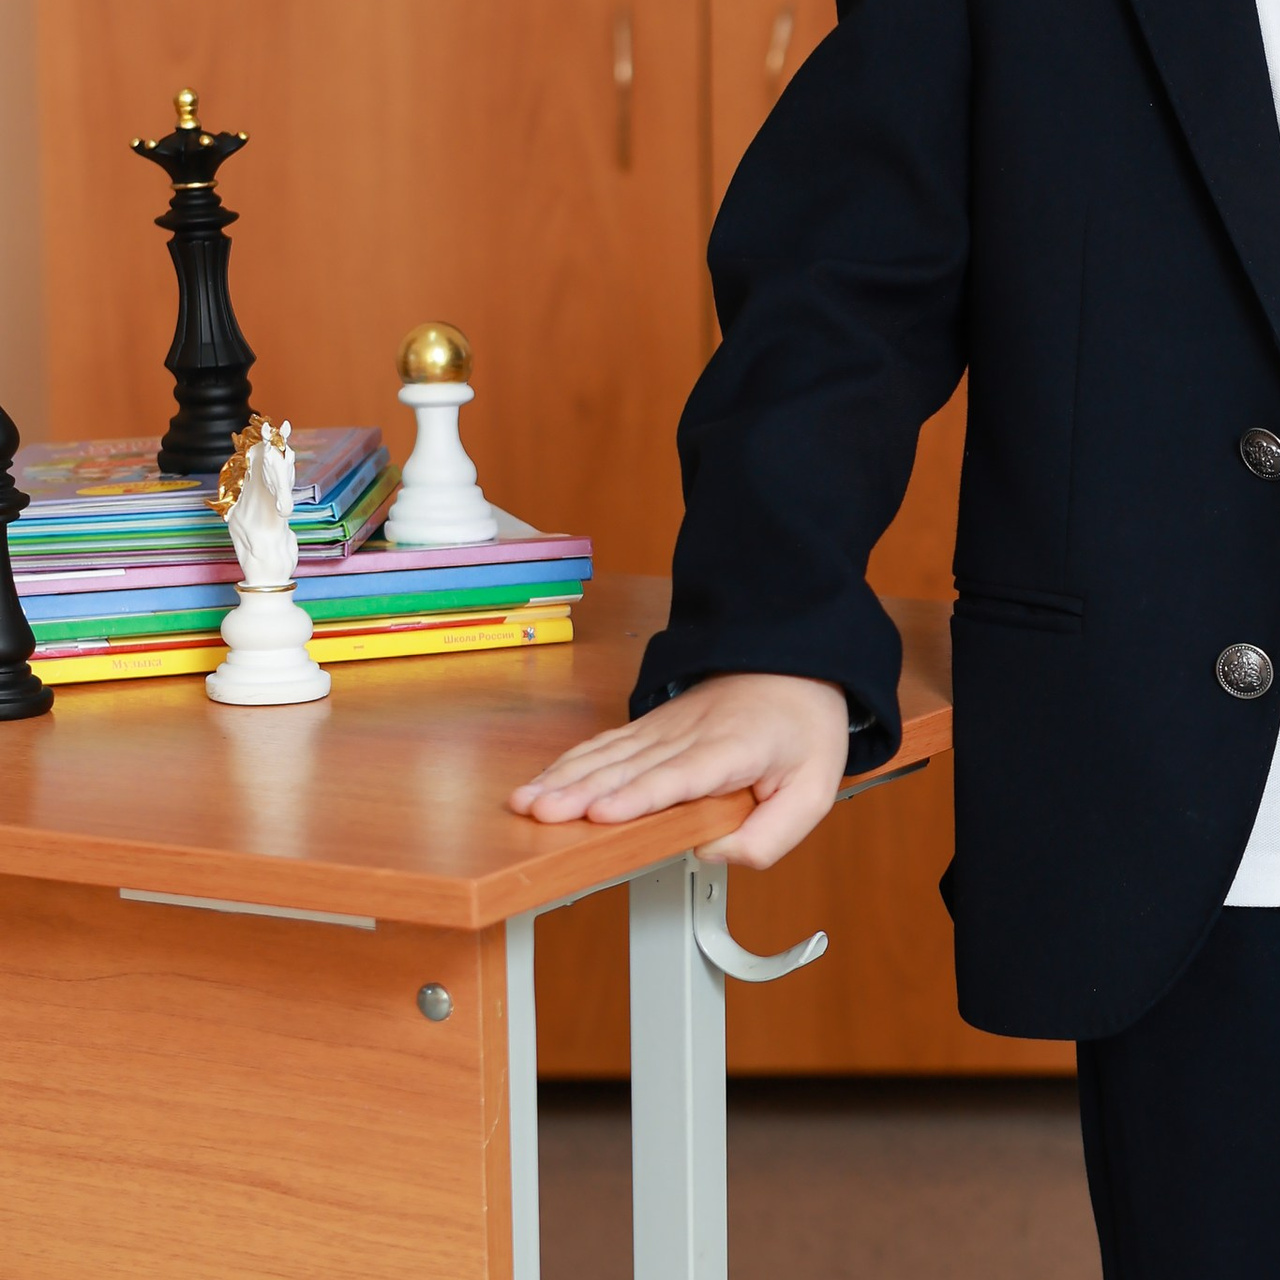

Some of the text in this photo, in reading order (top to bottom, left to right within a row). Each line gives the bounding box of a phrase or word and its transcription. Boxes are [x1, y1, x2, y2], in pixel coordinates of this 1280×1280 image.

[443, 631, 515, 644] Школа России
[112, 658, 163, 671] Музыка
